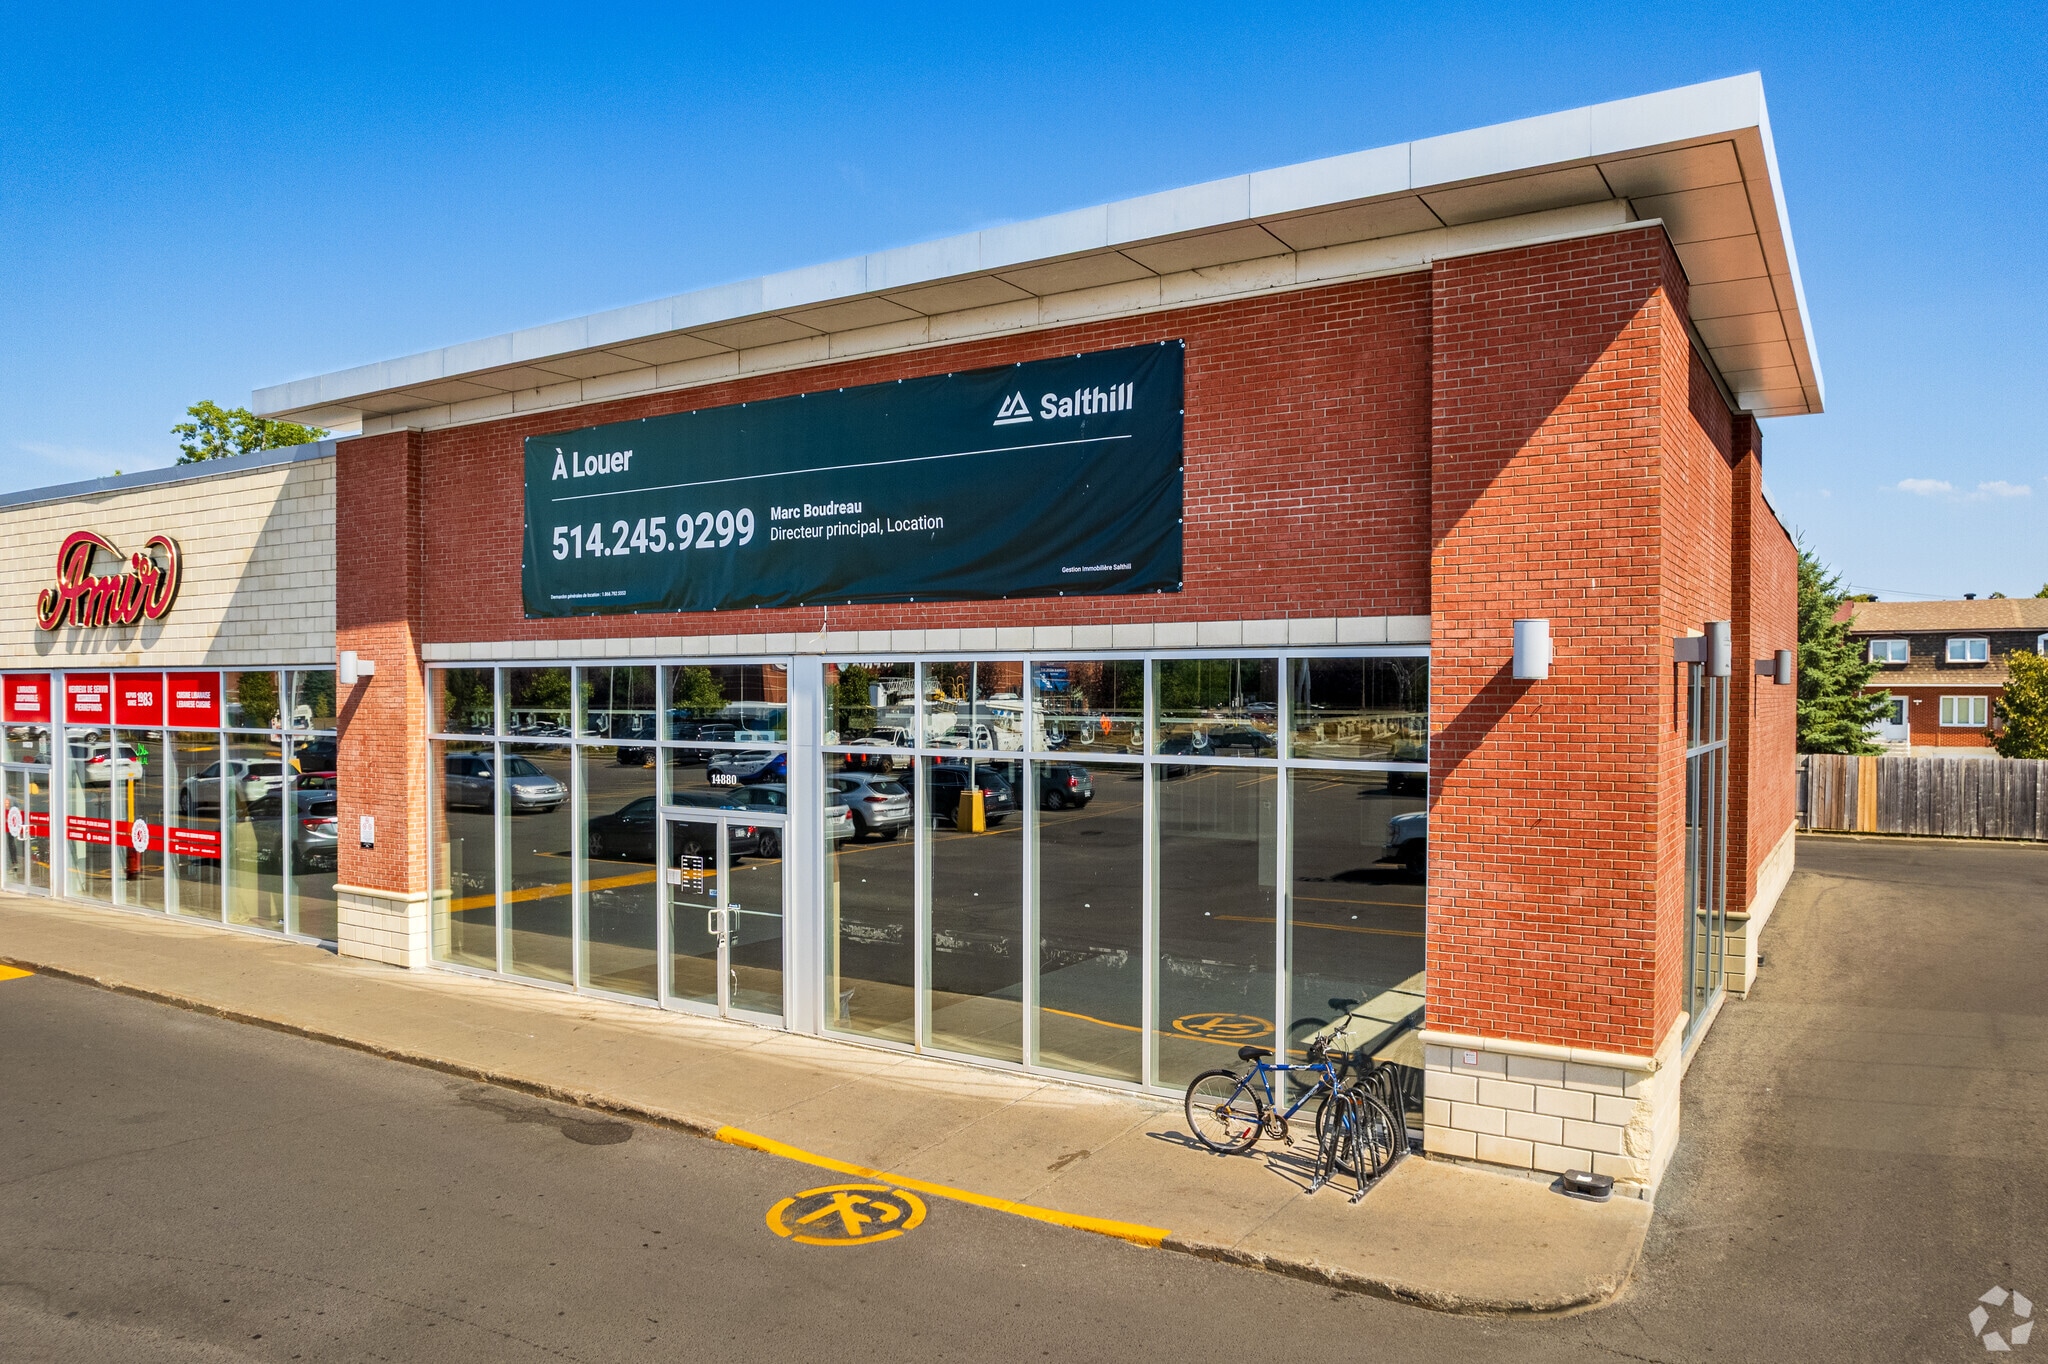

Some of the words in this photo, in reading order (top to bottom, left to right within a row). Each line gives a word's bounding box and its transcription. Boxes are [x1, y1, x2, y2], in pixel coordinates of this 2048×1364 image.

[1040, 381, 1134, 420] Salthill
[552, 447, 568, 481] À
[573, 449, 633, 478] Louer
[770, 506, 801, 521] Marc
[803, 500, 863, 518] Boudreau
[552, 507, 755, 561] 514.245.9299
[770, 525, 824, 541] Directeur
[826, 518, 884, 540] principal,
[887, 514, 944, 533] Location
[36, 530, 182, 631] Amir
[1062, 566, 1082, 574] Gestion
[137, 692, 153, 706] 1983
[711, 774, 737, 785] 14880
